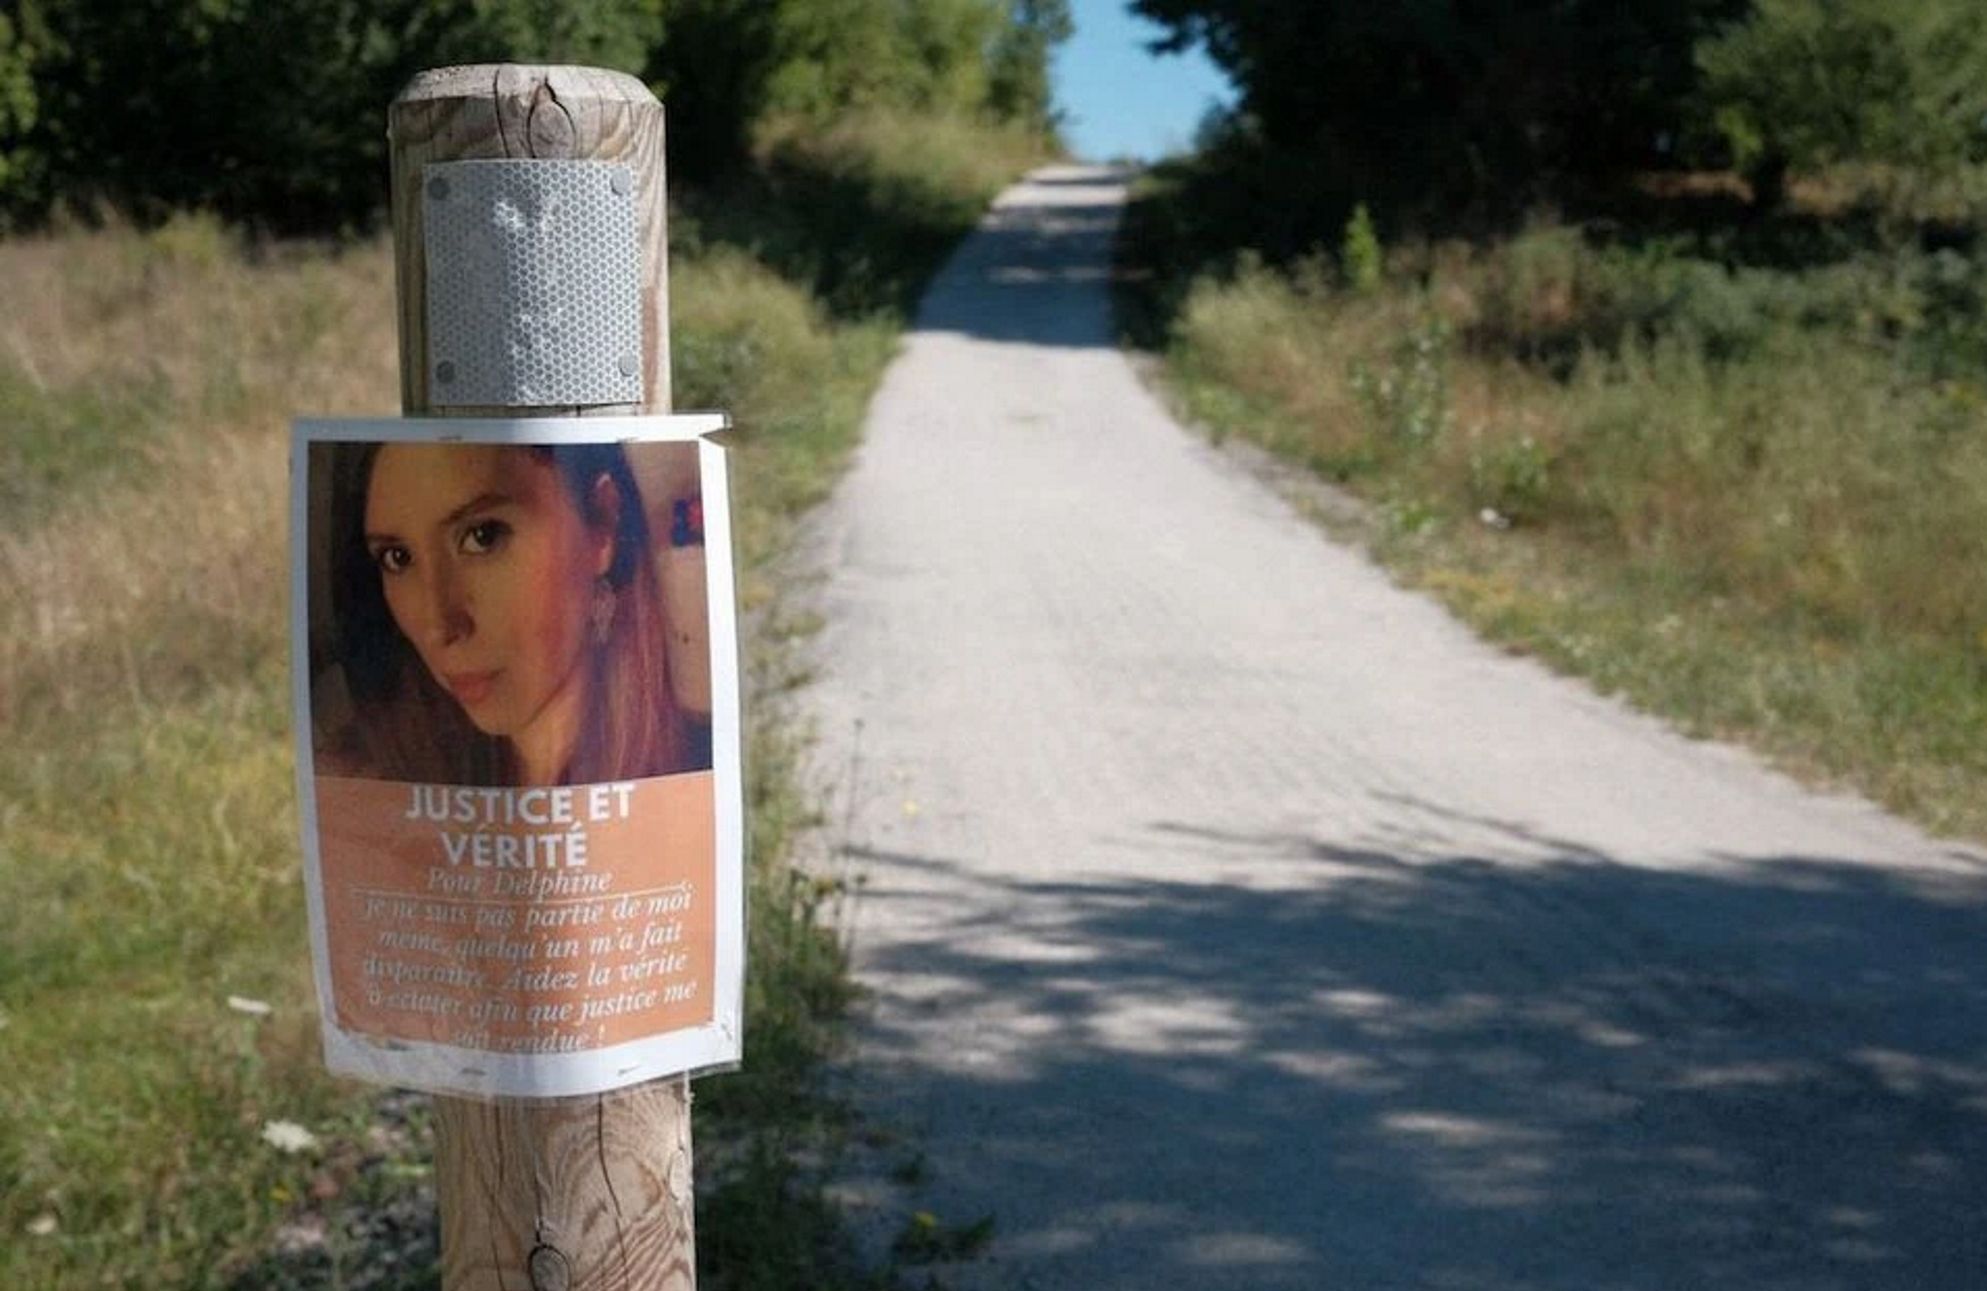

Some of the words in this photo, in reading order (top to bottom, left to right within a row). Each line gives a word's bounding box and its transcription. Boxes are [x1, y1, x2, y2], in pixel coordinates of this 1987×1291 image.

[405, 783, 573, 825] JUSTICE
[588, 783, 636, 822] ET
[440, 821, 588, 868] VÉRITÉ
[428, 867, 481, 892] Pour
[494, 868, 614, 902] Delphine
[474, 905, 516, 934] pas
[524, 902, 605, 934] partie
[612, 892, 642, 921] de
[647, 880, 695, 914] moi
[590, 926, 633, 955] m'a
[638, 915, 683, 956] fait
[587, 961, 612, 987] la
[619, 947, 688, 982] vérité
[525, 1003, 574, 1031] que
[574, 986, 658, 1027] justice
[663, 979, 698, 1005] me
